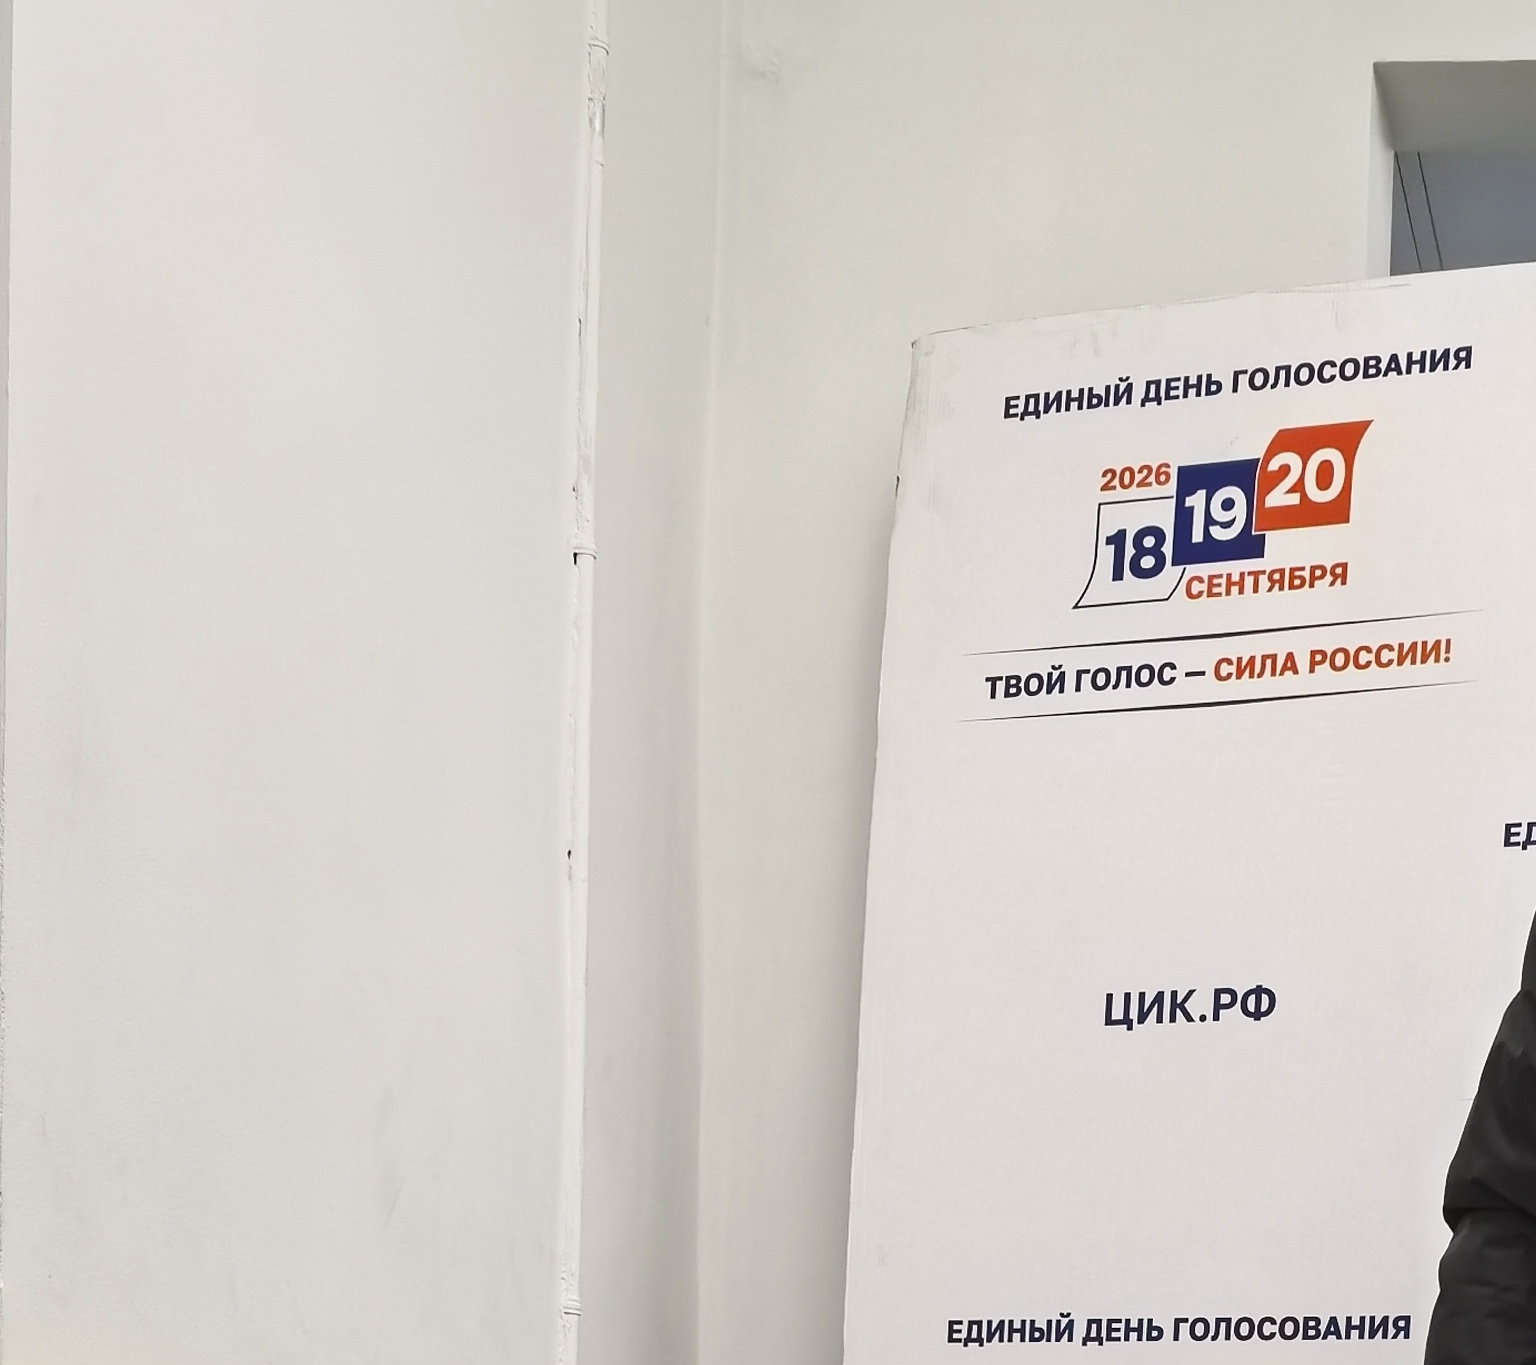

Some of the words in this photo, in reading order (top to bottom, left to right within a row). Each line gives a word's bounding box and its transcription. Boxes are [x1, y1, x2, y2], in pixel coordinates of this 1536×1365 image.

[1003, 375, 1134, 422] ЕДИНЫЙ
[1140, 373, 1223, 408] ДЕНЬ
[1231, 345, 1473, 394] ГОЛОСОВАНИЯ
[1099, 462, 1171, 492] 2026
[1264, 447, 1346, 508] 20
[1184, 485, 1247, 544] 19
[1104, 525, 1167, 582] 18
[1184, 561, 1349, 600] СЕНТЯБРЯ
[984, 664, 1066, 700] ТВОЙ
[1074, 661, 1178, 693] ГОЛОС
[1213, 651, 1300, 682] СИЛА
[1308, 638, 1451, 674] РОССИИ!
[1104, 984, 1277, 1032] ЦИК.РФ
[947, 1312, 1075, 1348] ЕДИНЫЙ
[1081, 1317, 1165, 1347] ДЕНЬ
[1172, 1314, 1412, 1342] ГОЛОСОВАНИЯ
